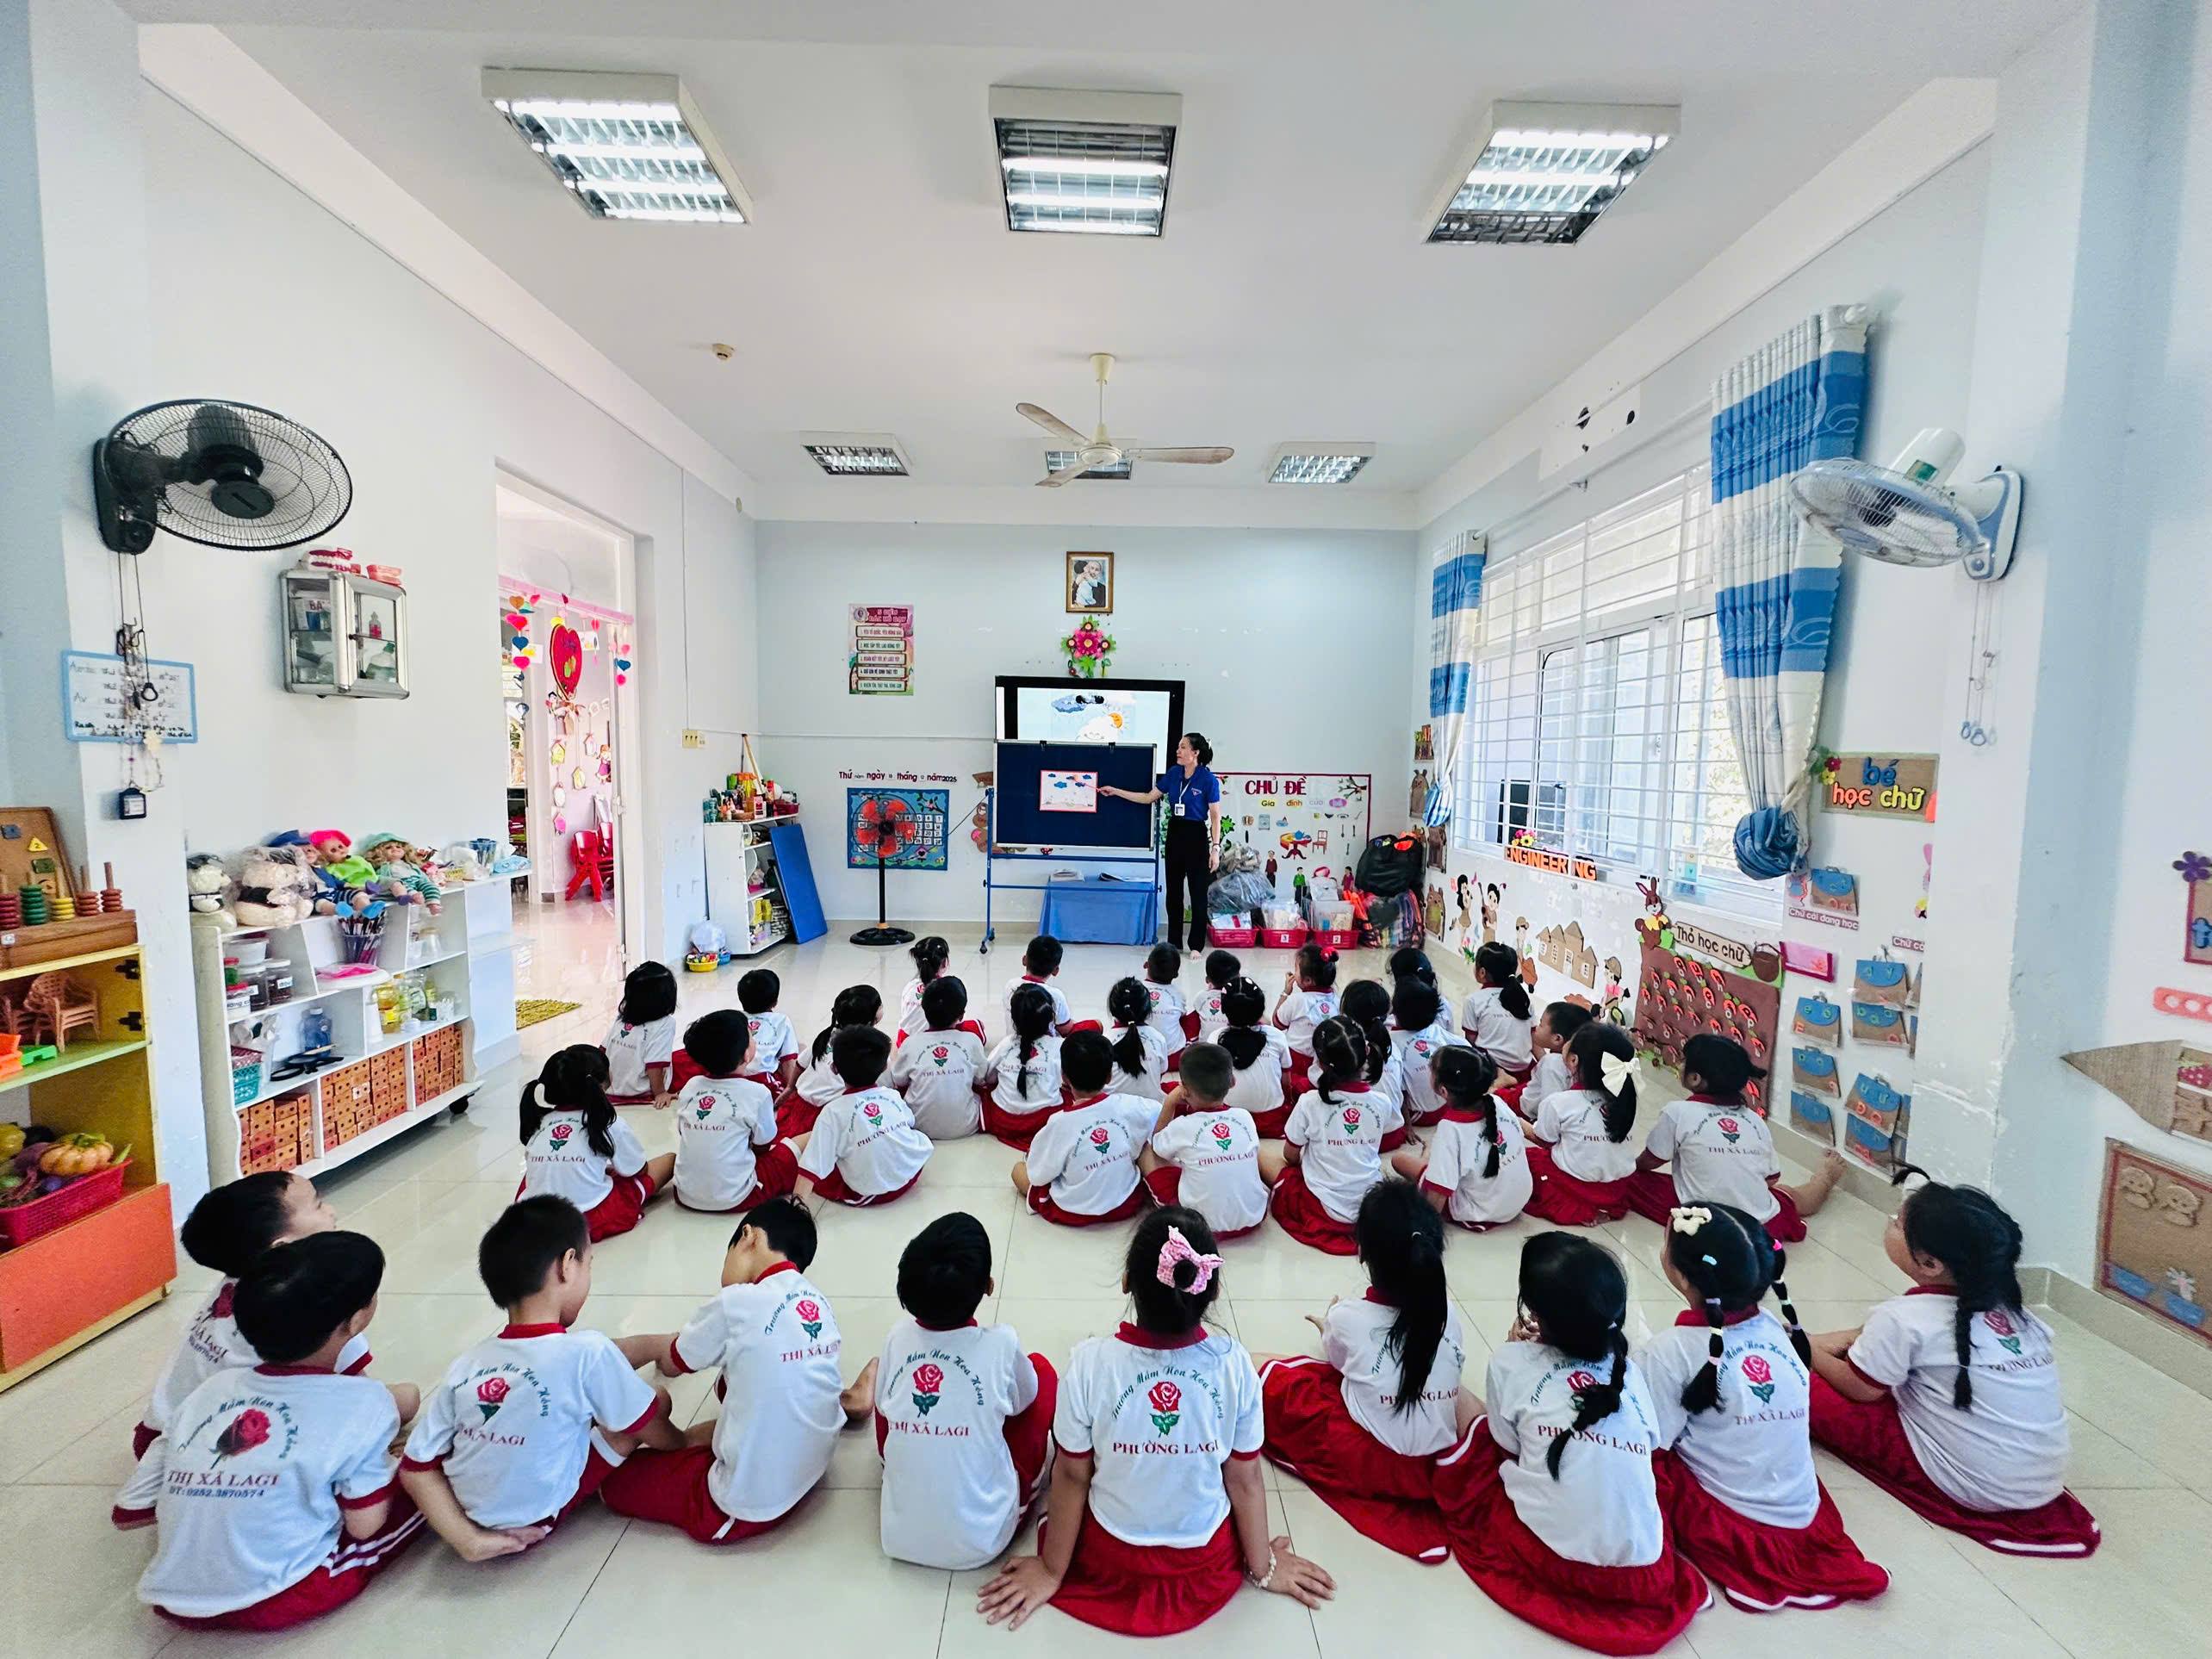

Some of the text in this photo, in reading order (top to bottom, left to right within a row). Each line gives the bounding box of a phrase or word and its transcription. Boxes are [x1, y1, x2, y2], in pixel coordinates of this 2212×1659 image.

[839, 768, 853, 779] Thứ
[867, 769, 885, 780] ngày
[897, 771, 917, 782] tháng
[1862, 757, 1899, 786] bé
[1245, 775, 1307, 796] CHỦ ĐỀ
[1833, 781, 1925, 811] học chữ
[1677, 926, 1743, 962] Thỏ học chữ
[911, 1422, 969, 1437] XÃ LAGI
[1113, 1440, 1218, 1455] PHƯỜNG LAGI
[168, 1470, 279, 1488] THỊ XÃ LAGI
